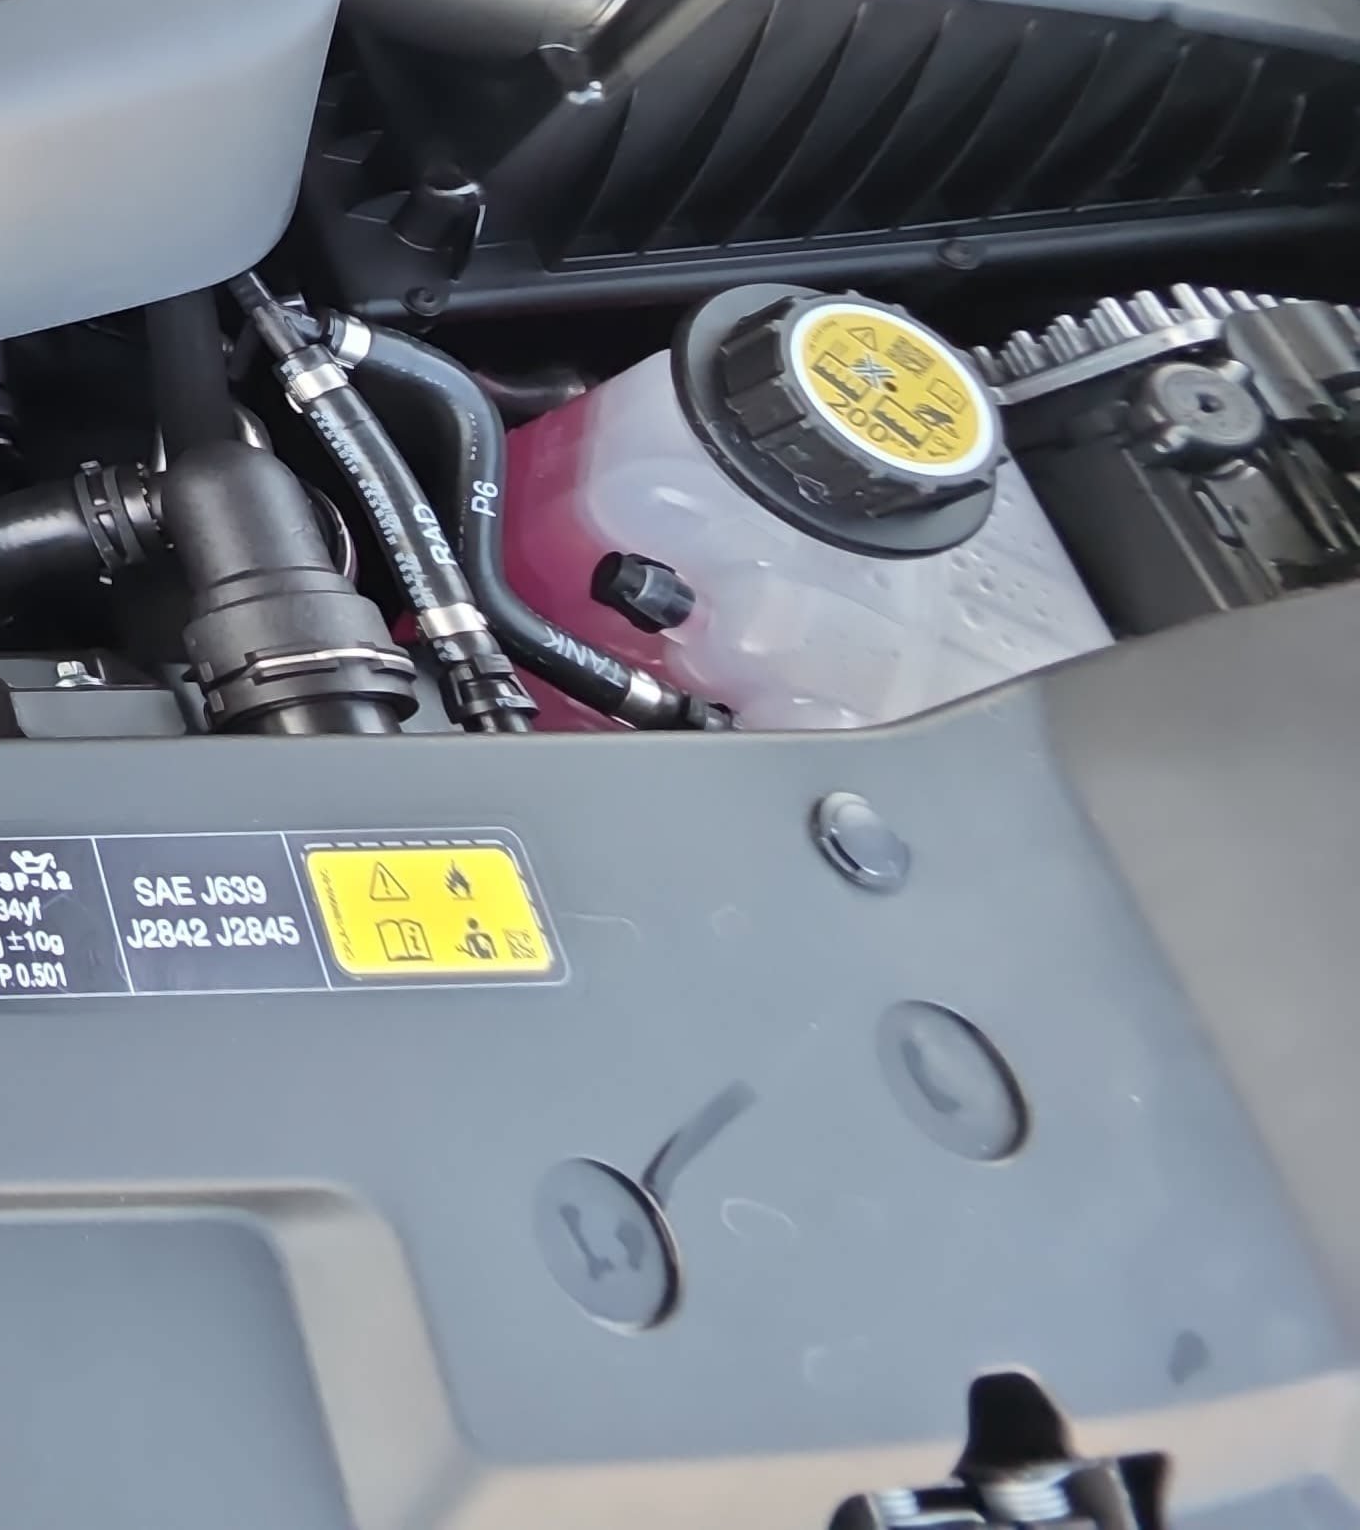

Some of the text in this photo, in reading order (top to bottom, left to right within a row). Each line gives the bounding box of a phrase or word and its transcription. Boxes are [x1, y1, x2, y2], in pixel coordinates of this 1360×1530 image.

[827, 392, 889, 443] 200
[470, 480, 499, 517] P6
[412, 503, 458, 566] RAD
[542, 626, 627, 689] TANK
[133, 875, 268, 906] SAE J639
[7, 929, 65, 956] ±10g
[126, 916, 301, 948] J2842 J2845
[17, 962, 68, 988] 0.501
